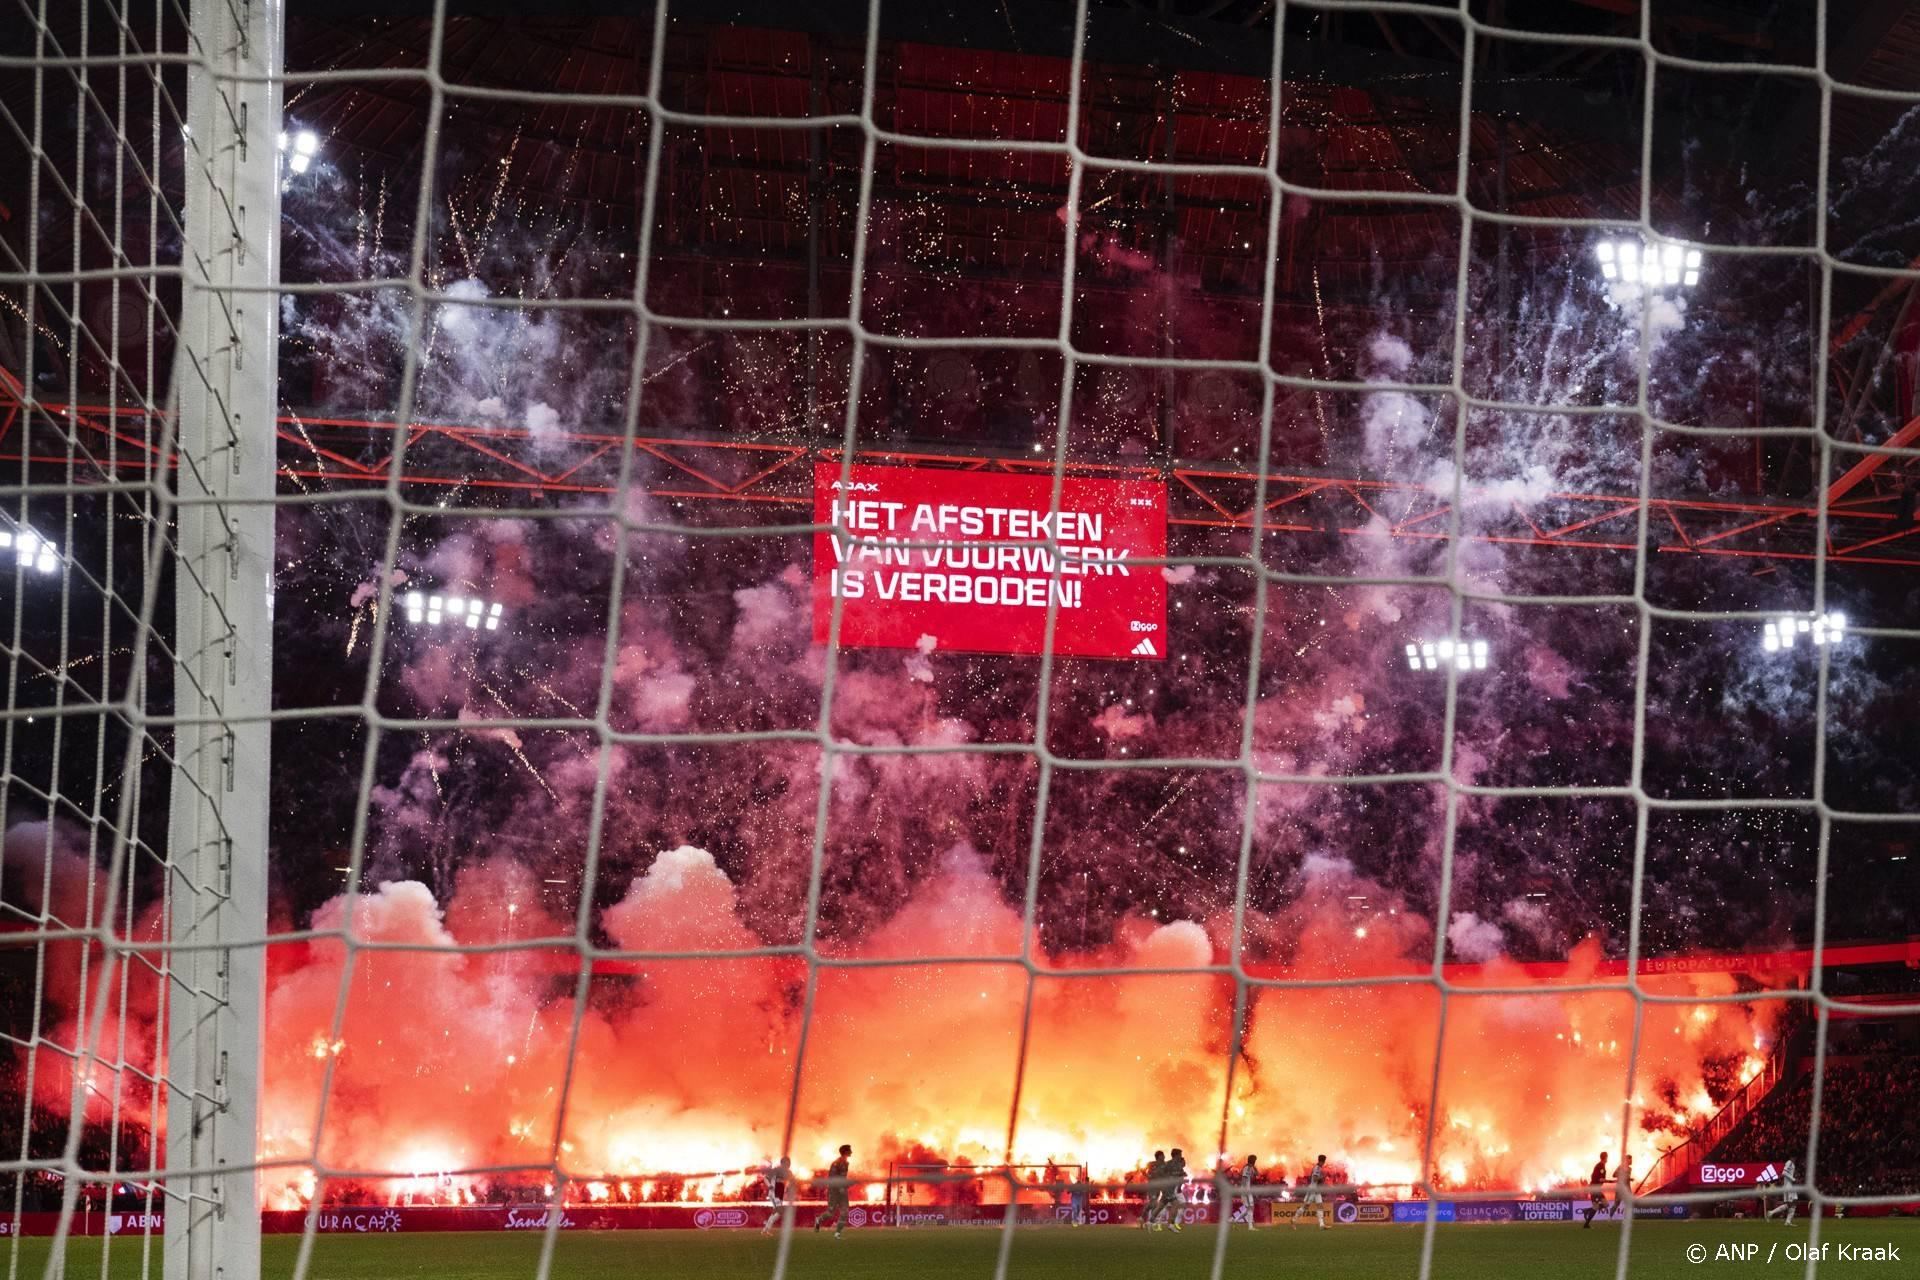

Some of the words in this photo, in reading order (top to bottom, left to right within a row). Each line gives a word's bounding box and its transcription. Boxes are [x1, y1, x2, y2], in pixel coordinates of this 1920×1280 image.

[831, 480, 879, 492] AJAX
[831, 499, 904, 531] HET
[911, 503, 1103, 542] AFSTEKEN
[831, 534, 910, 566] VAN
[921, 539, 1130, 577] VUURWERK
[831, 568, 865, 598] IS
[873, 570, 1082, 608] VERBODEN!
[1645, 959, 1709, 972] EUROPA
[1715, 957, 1746, 969] CUP
[1518, 1202, 1570, 1211] VRIENDEN
[1524, 1211, 1563, 1221] LOTERIJ
